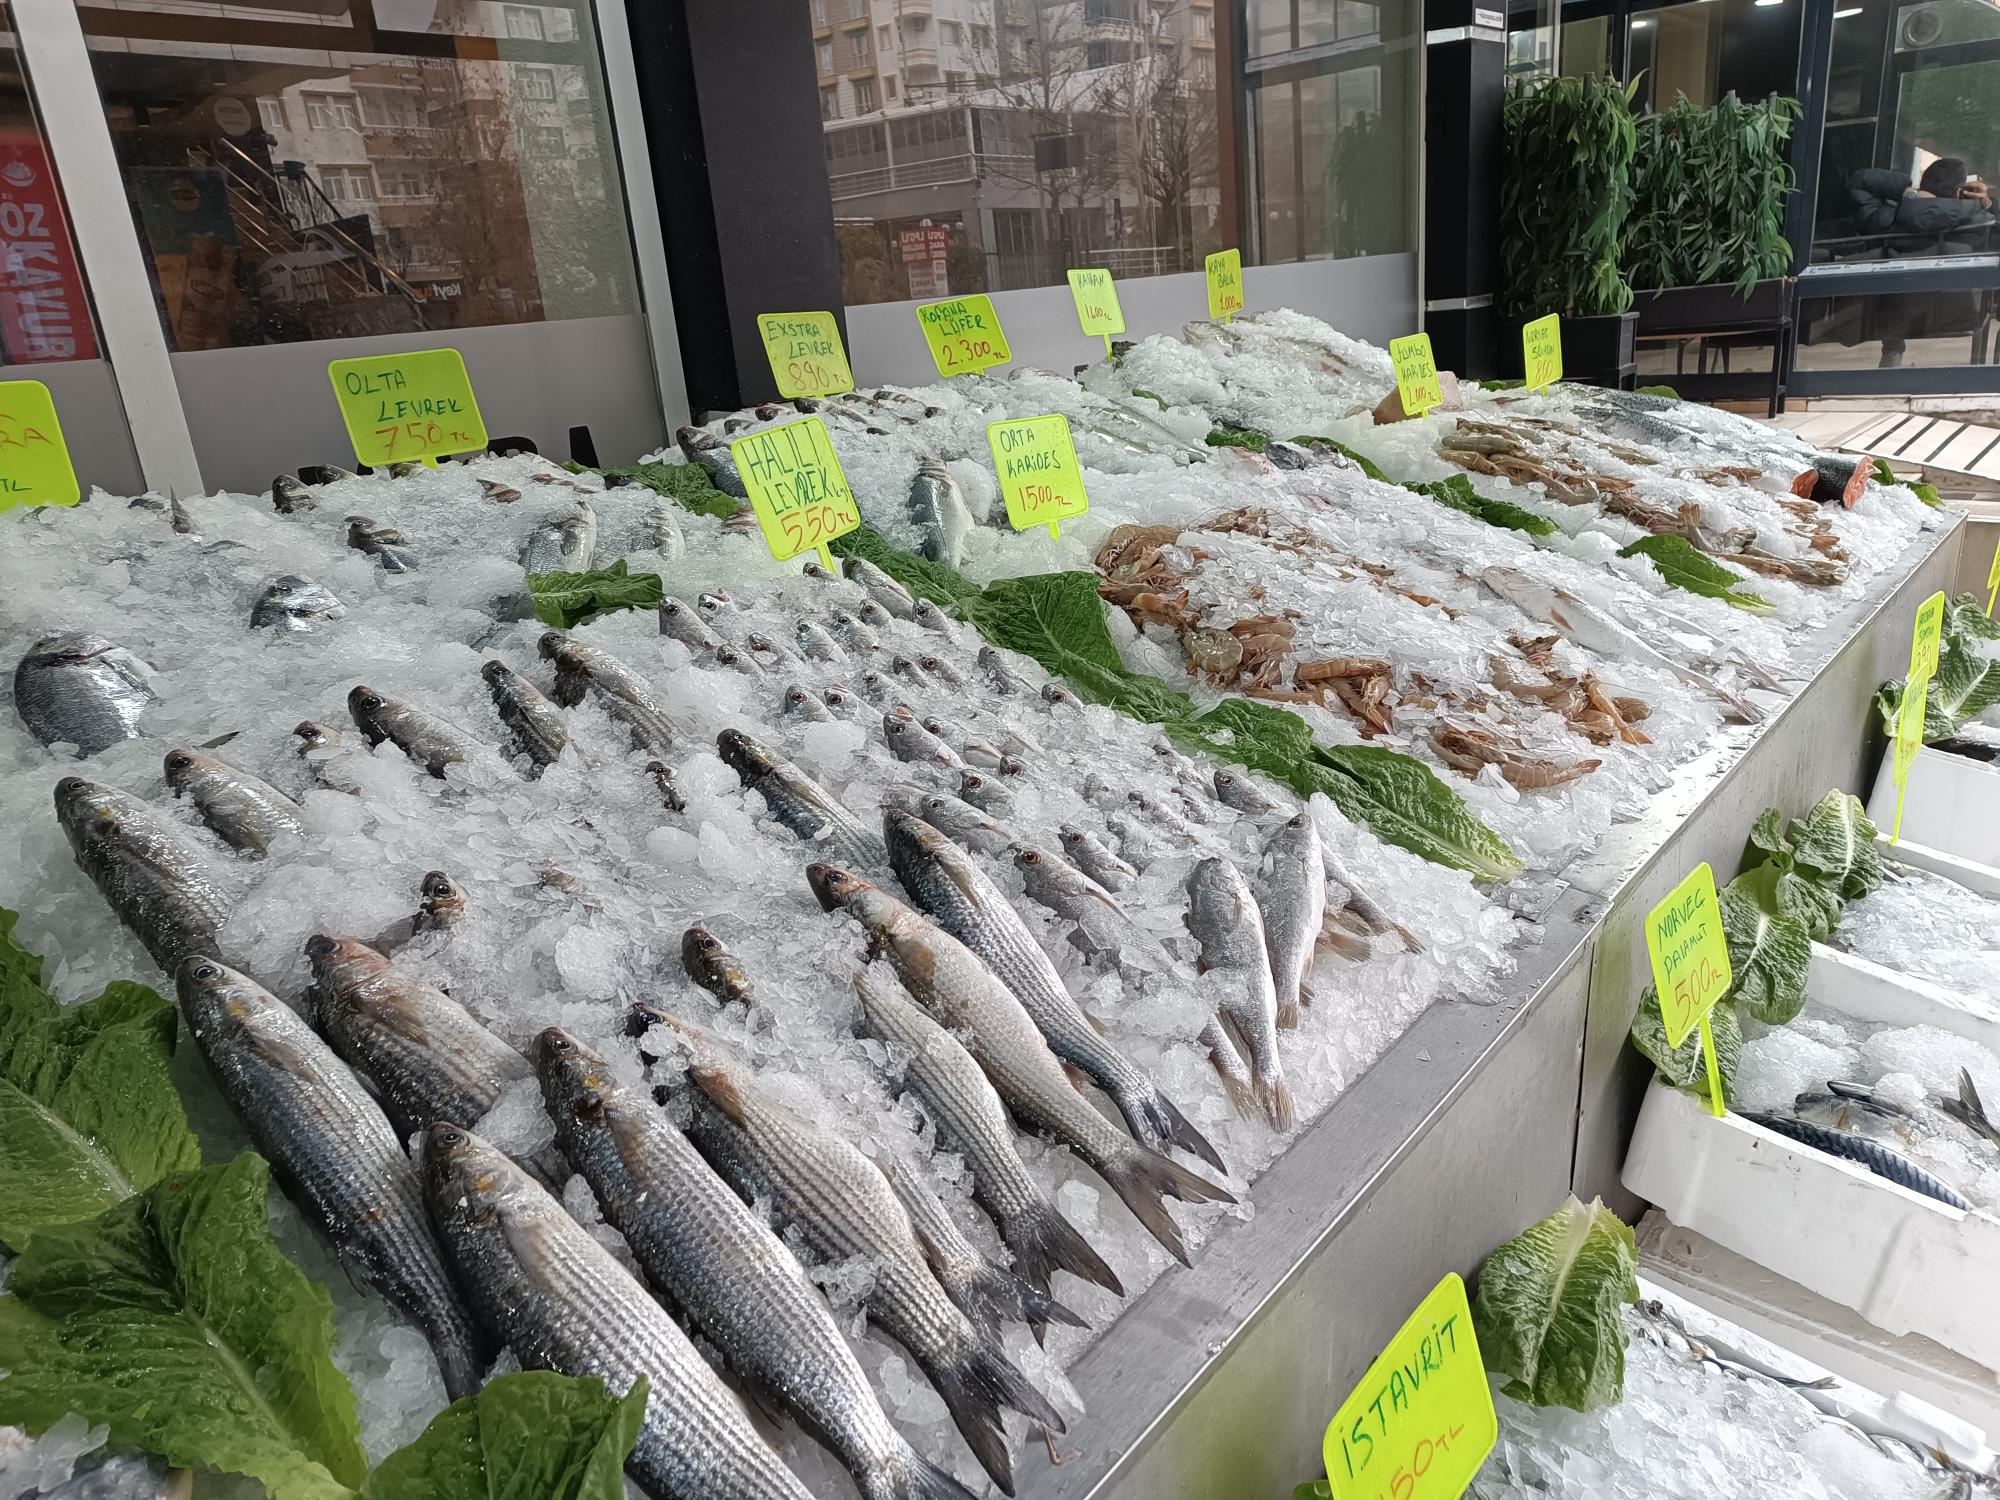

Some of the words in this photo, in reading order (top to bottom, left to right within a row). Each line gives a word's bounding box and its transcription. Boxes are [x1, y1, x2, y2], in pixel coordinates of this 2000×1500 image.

[9, 240, 76, 360] KAVUR
[919, 302, 968, 324] KOFANA
[939, 314, 988, 337] LÜFER
[788, 341, 834, 360] LEVREK
[943, 339, 991, 366] 2.300
[345, 369, 407, 395] OLTA
[788, 361, 830, 391] 890
[377, 398, 464, 423] LEVREK
[375, 421, 442, 460] 750
[1000, 428, 1035, 453] ORTA
[1006, 449, 1061, 478] KARİDES
[763, 466, 834, 516] LEVREK
[1055, 495, 1073, 507] TL
[780, 506, 837, 553] 550
[837, 513, 857, 526] TL
[1674, 957, 1711, 1029] 500
